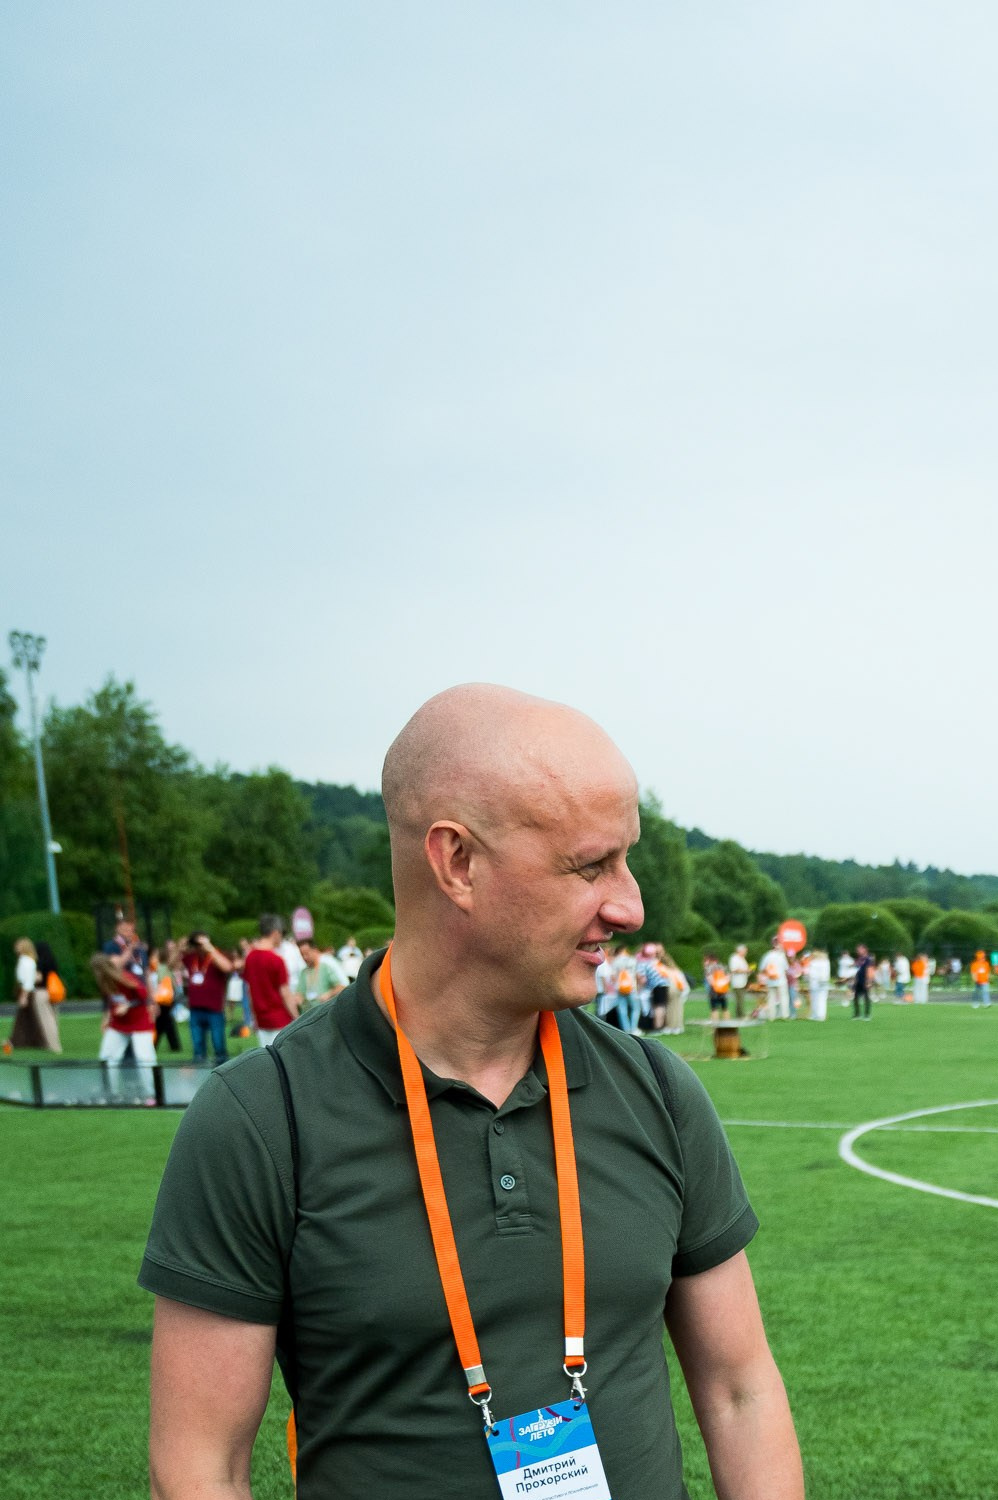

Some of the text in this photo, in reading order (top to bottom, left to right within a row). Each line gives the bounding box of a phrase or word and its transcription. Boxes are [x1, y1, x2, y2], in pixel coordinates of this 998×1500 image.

[529, 1427, 555, 1441] ЛЕТО
[515, 1465, 588, 1493] Прохорский
[523, 1456, 576, 1480] Дмитрий
